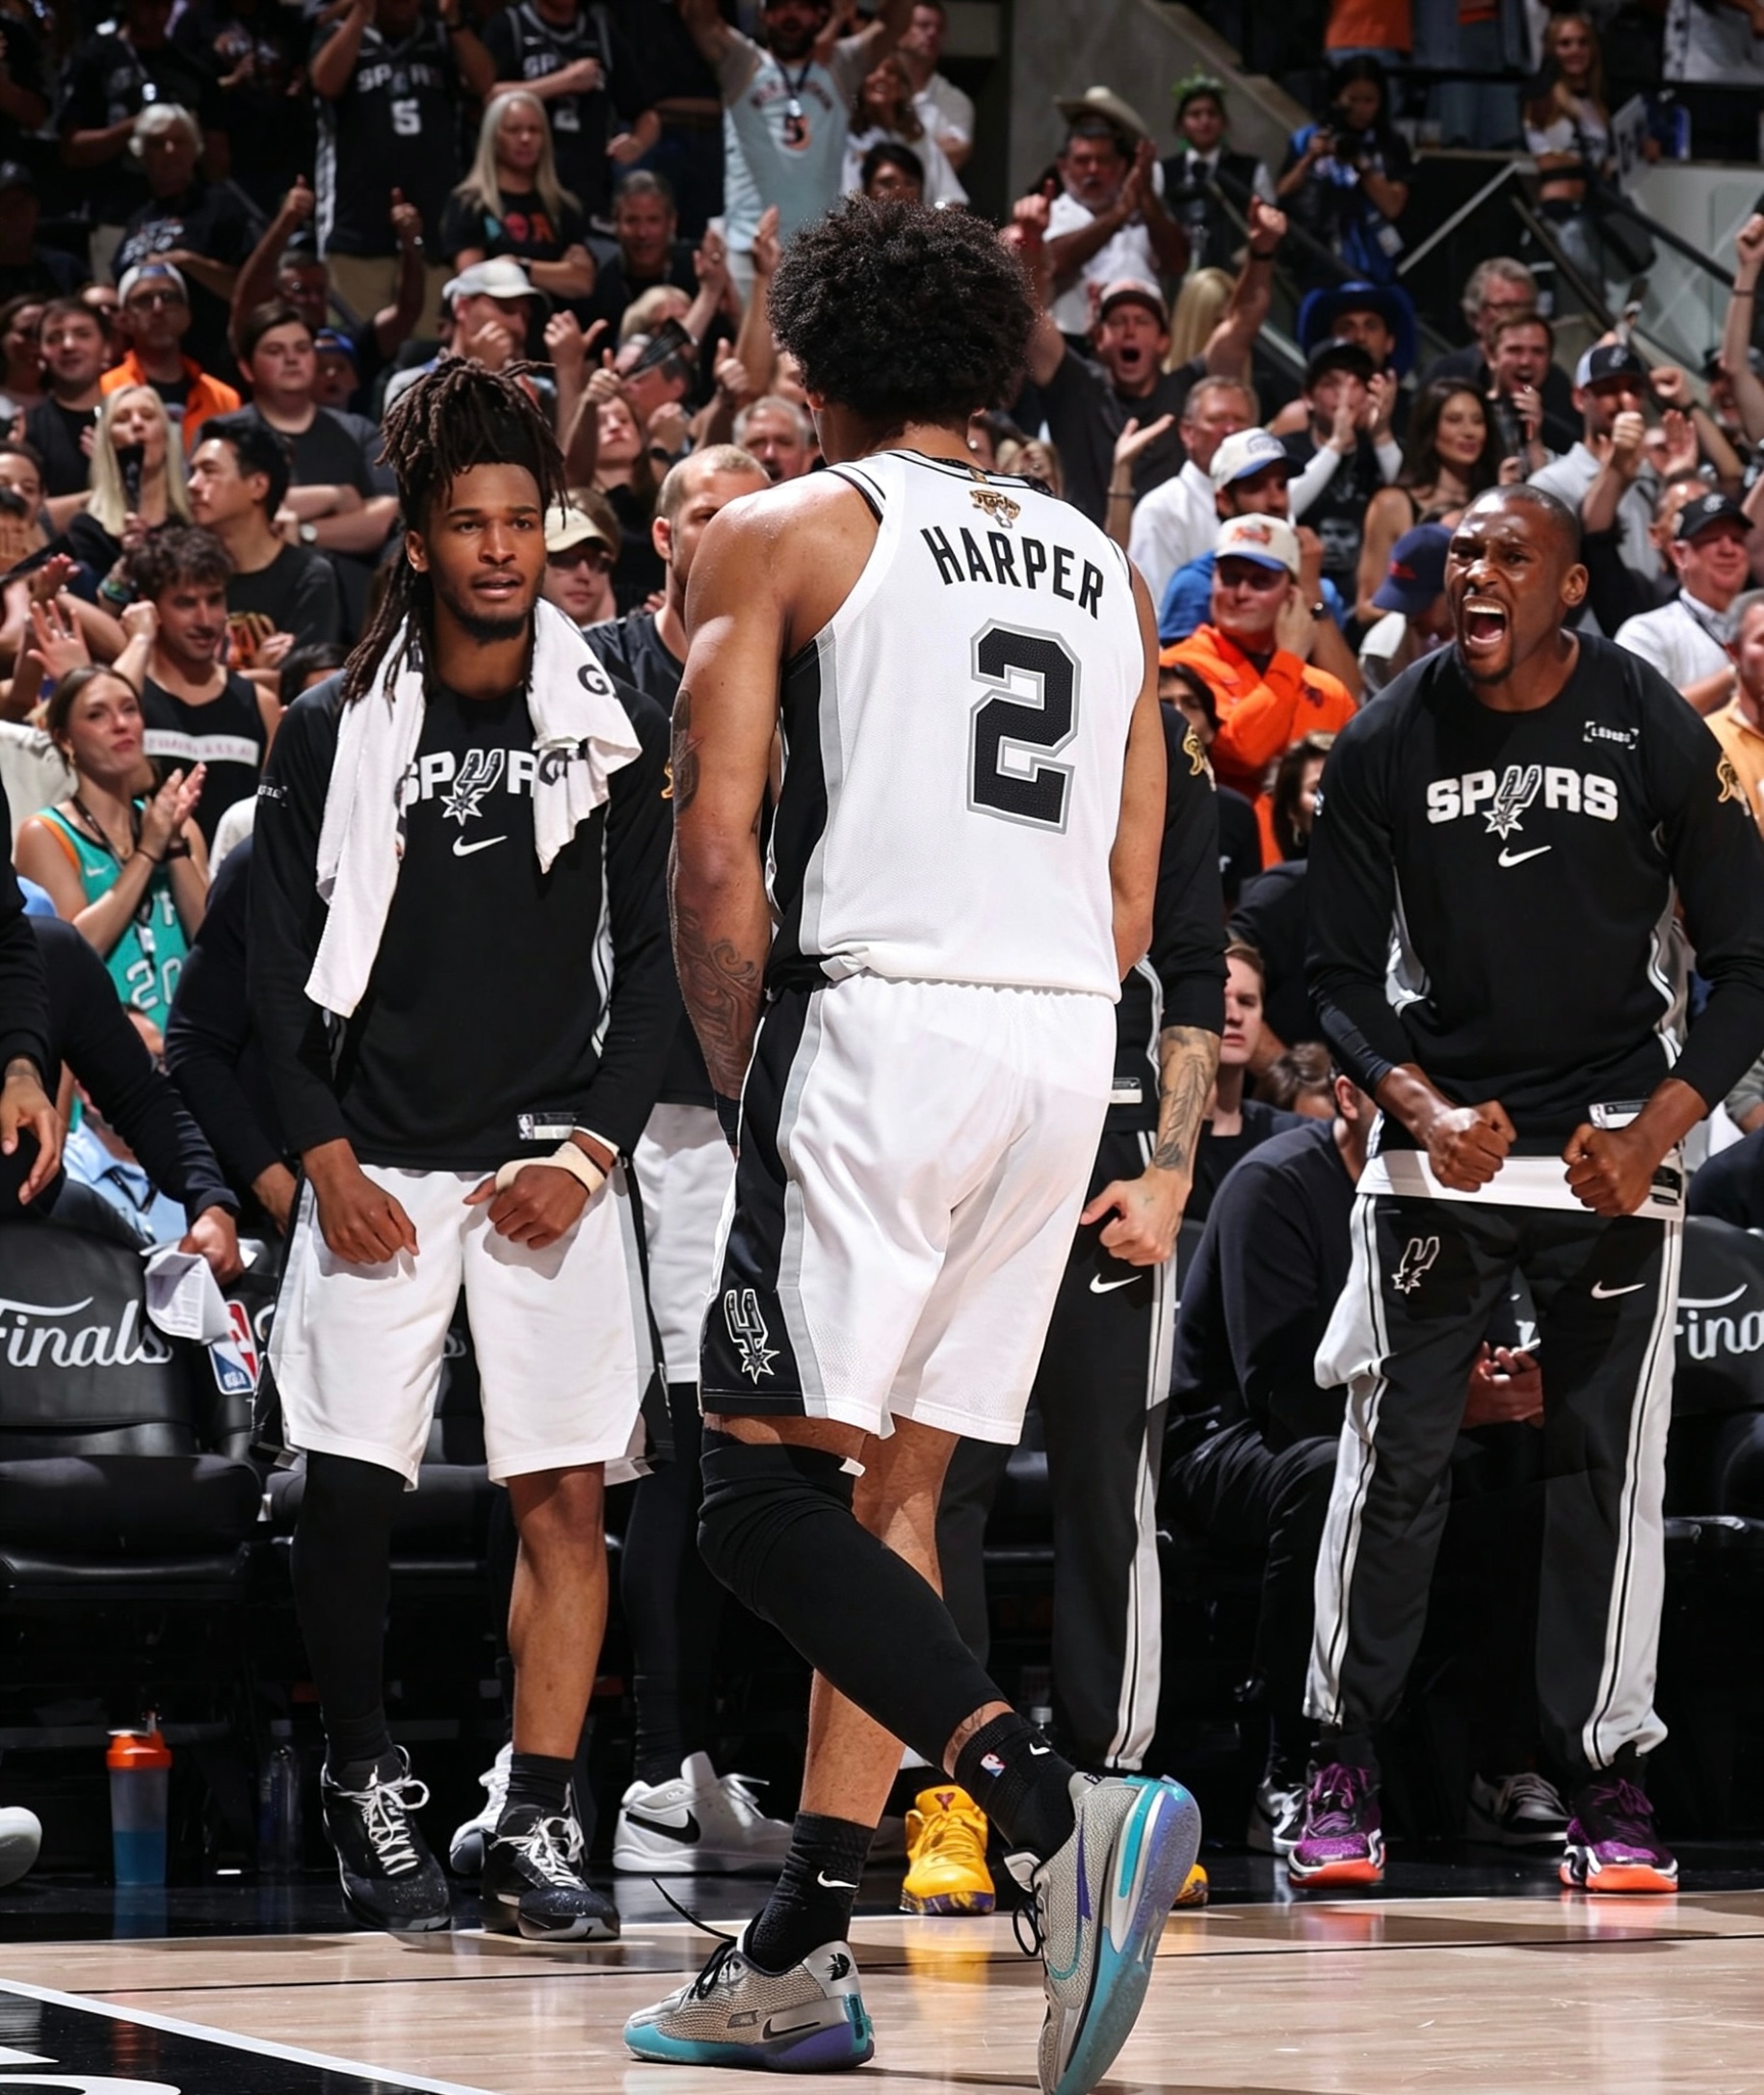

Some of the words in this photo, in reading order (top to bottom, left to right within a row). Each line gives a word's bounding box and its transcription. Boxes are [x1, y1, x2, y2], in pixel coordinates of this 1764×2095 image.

[391, 98, 422, 136] 5
[920, 525, 1104, 621] HARPER
[966, 618, 1082, 835] 2
[1426, 764, 1619, 841] SPURS
